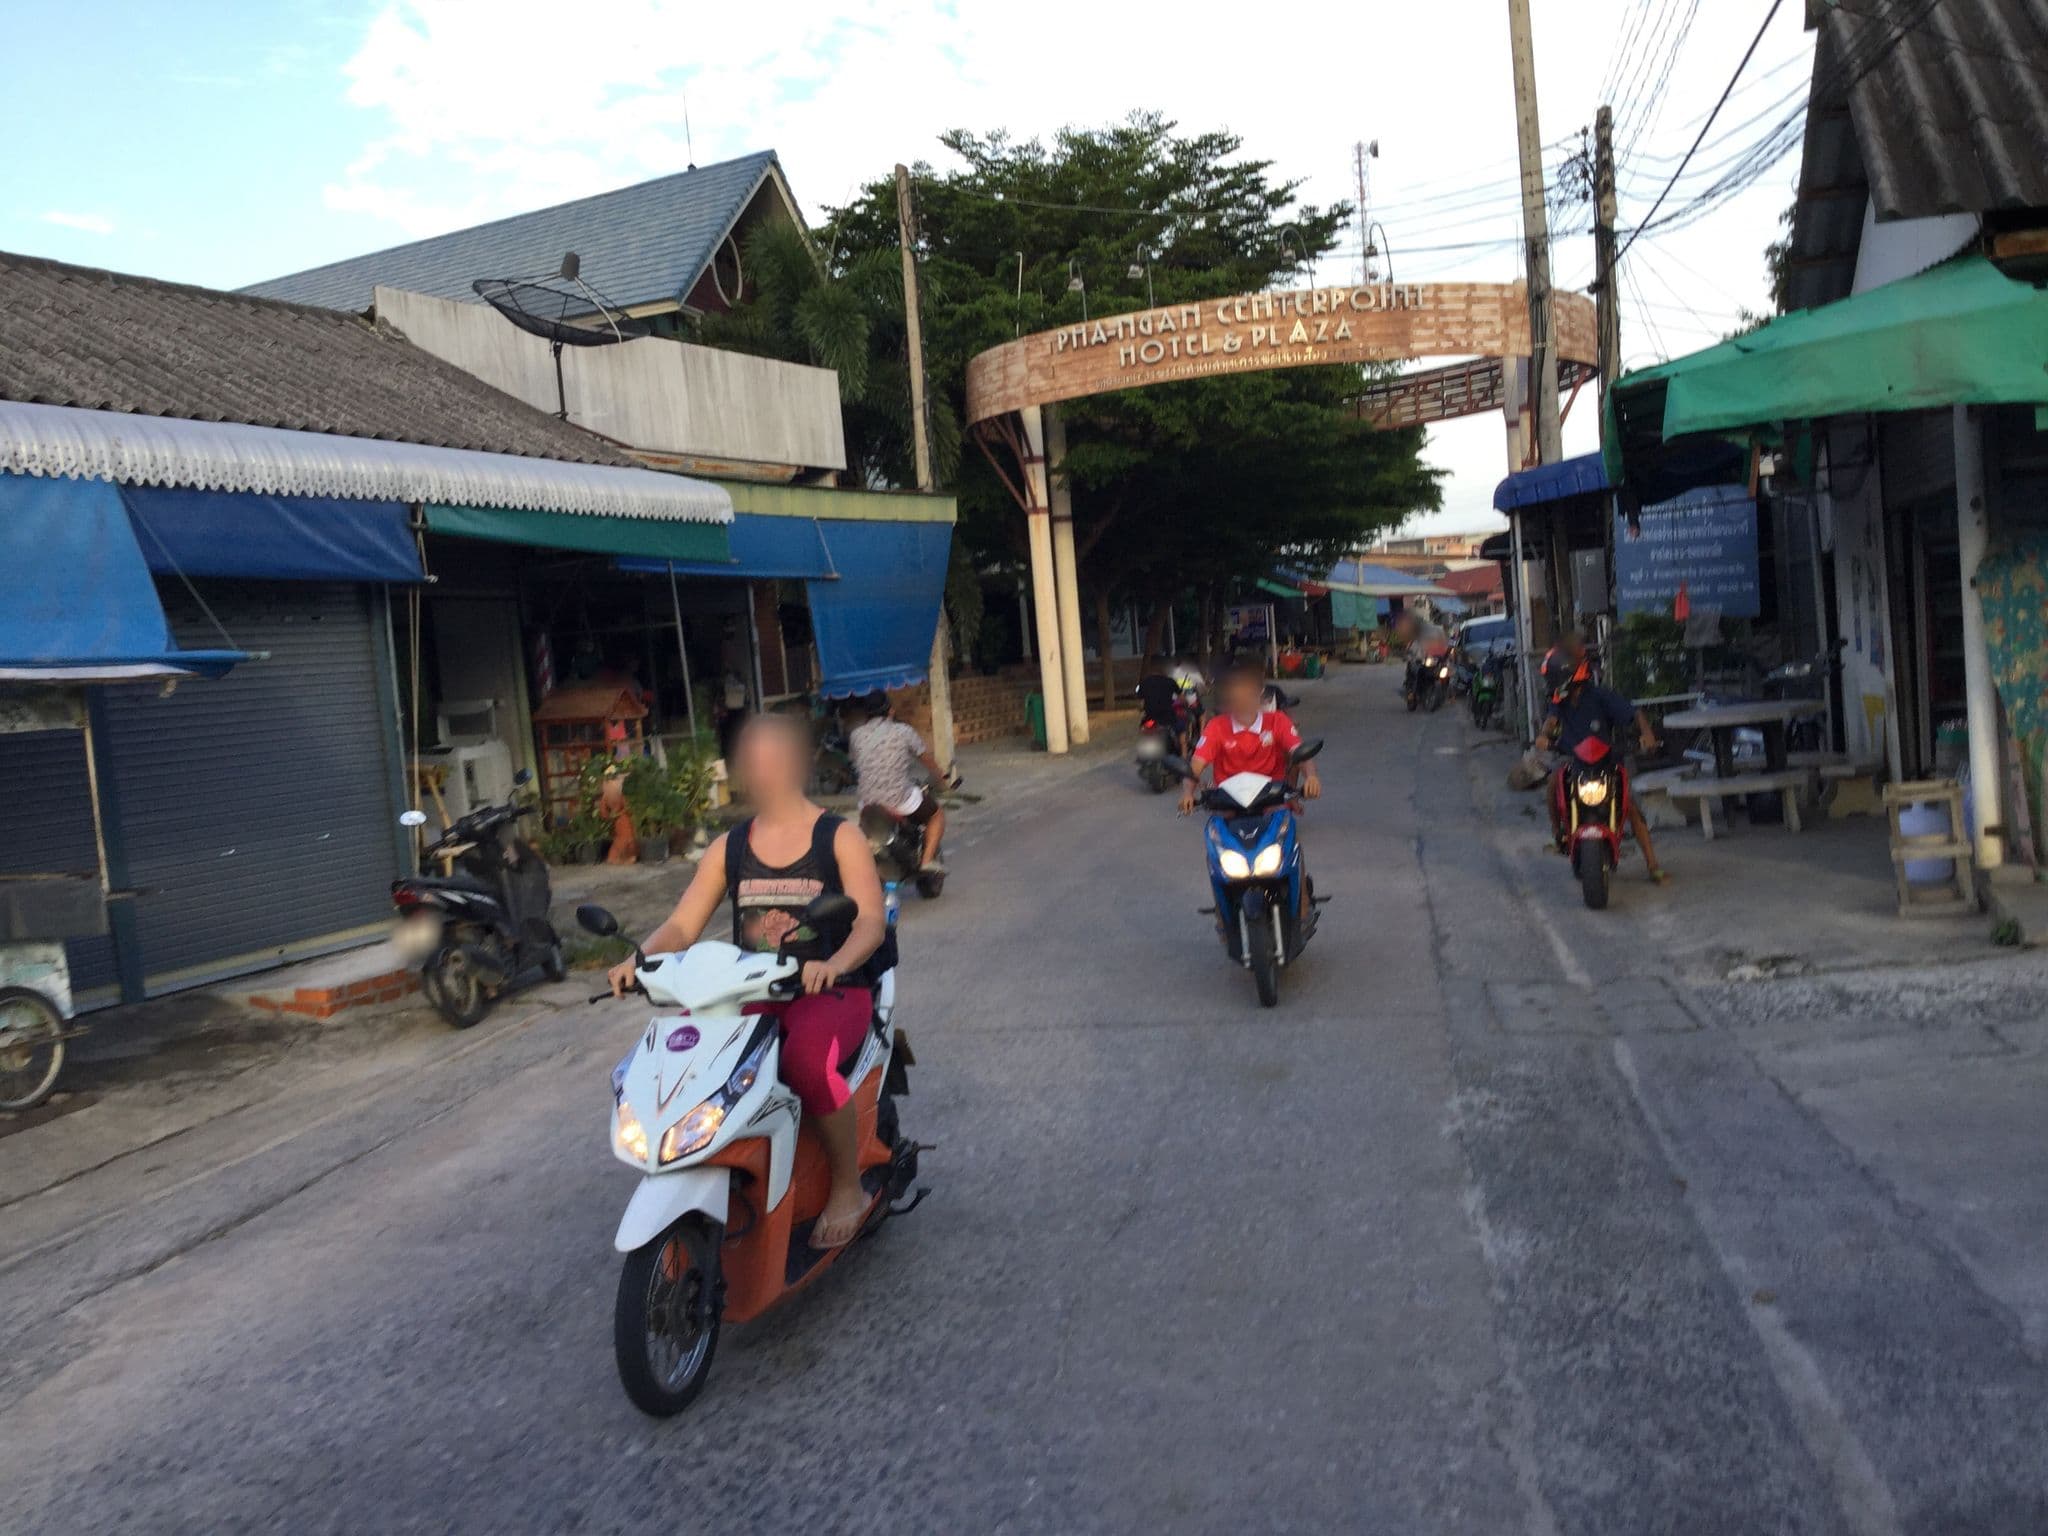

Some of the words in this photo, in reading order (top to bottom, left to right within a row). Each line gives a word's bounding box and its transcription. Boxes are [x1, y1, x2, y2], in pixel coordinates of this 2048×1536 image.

[1057, 303, 1202, 352] PHA-NGAN
[1215, 284, 1425, 326] CENTERPOINT
[1120, 333, 1216, 368] HOTEL
[1223, 332, 1244, 353] &
[1251, 316, 1355, 348] PLAZA
